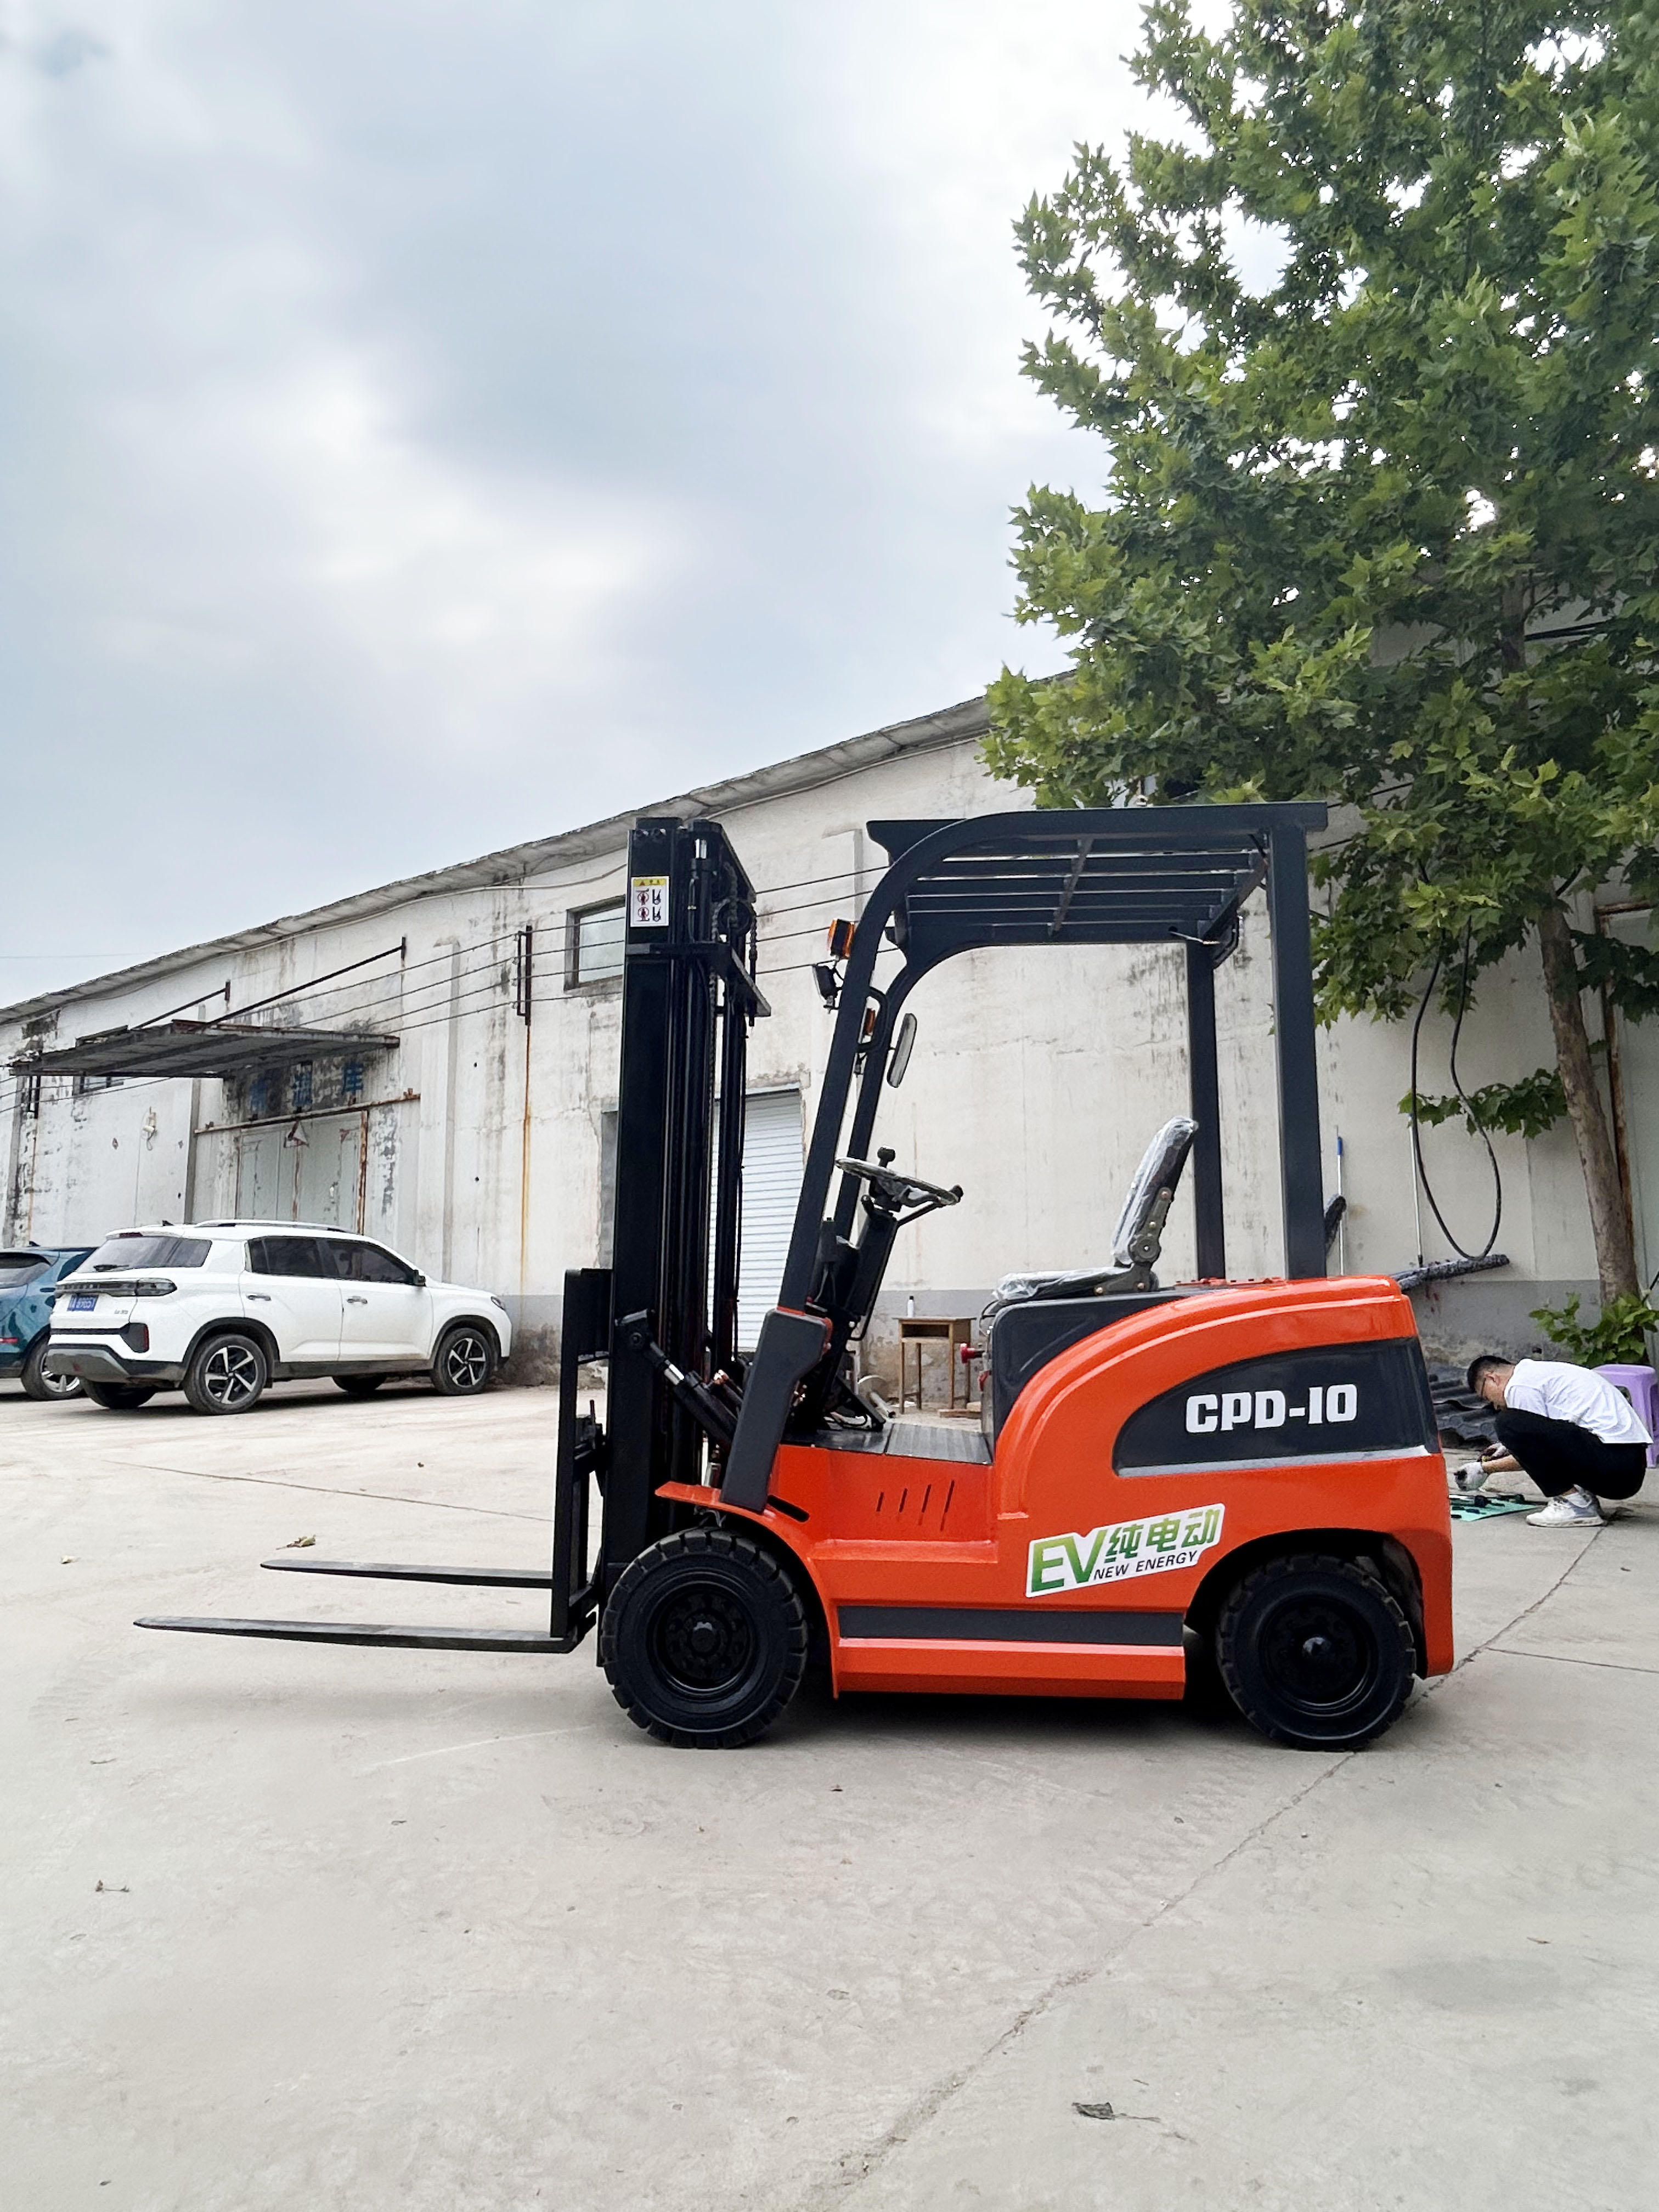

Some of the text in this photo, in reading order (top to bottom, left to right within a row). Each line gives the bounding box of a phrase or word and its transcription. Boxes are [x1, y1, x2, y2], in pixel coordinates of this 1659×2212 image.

[1186, 1384, 1357, 1433] CPD-10
[1031, 1509, 1220, 1593] EV 纯电动
[1094, 1550, 1198, 1581] NEW ENERGY
